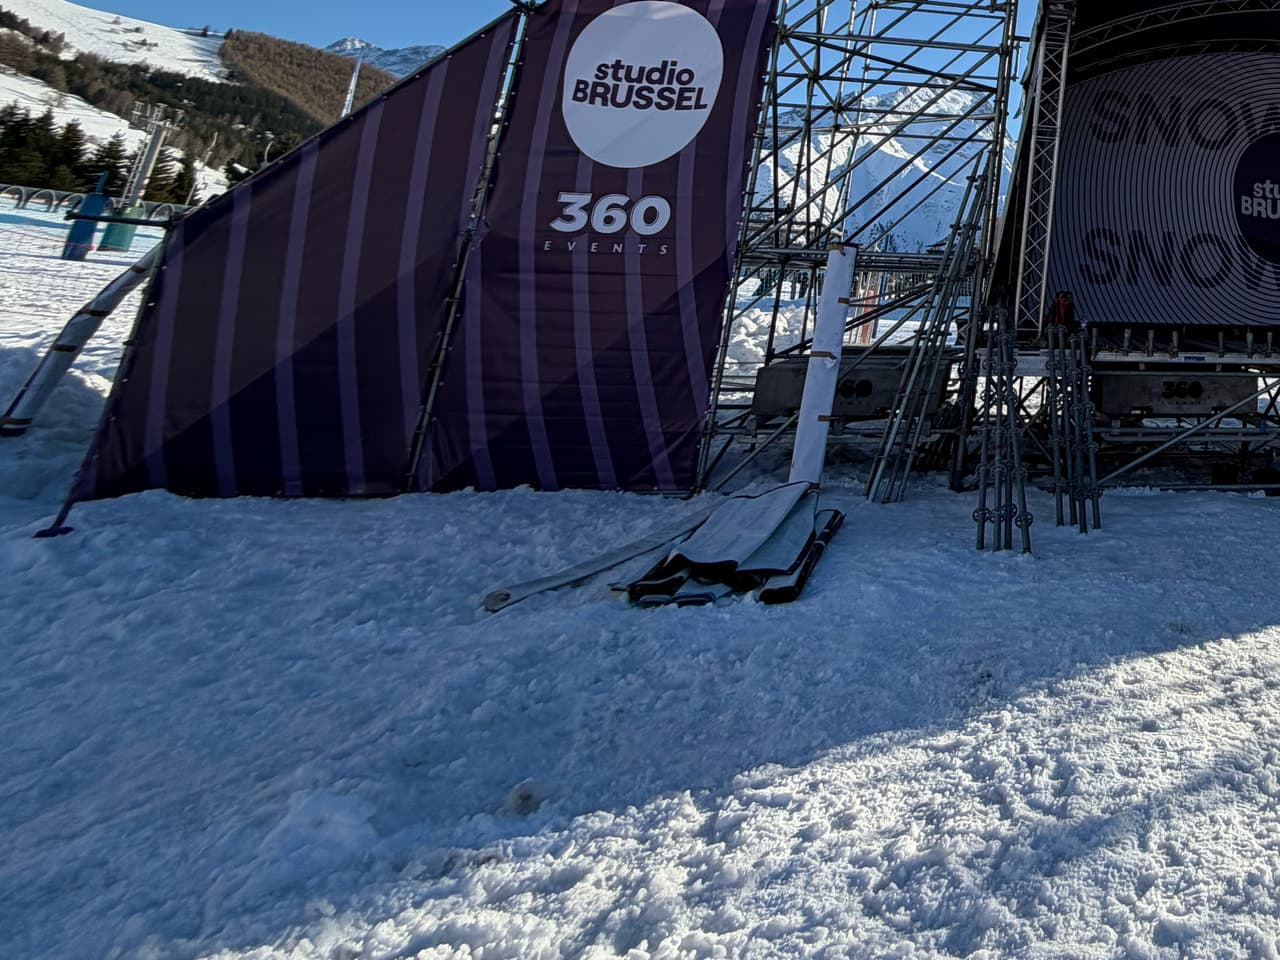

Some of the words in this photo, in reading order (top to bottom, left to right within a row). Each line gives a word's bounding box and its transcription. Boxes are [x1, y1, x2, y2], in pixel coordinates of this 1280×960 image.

[594, 59, 695, 86] studio
[572, 79, 708, 111] BRUSSEL
[550, 191, 671, 235] 360
[544, 241, 668, 255] EVENTS
[838, 379, 873, 398] 60
[1162, 381, 1203, 399] 360
